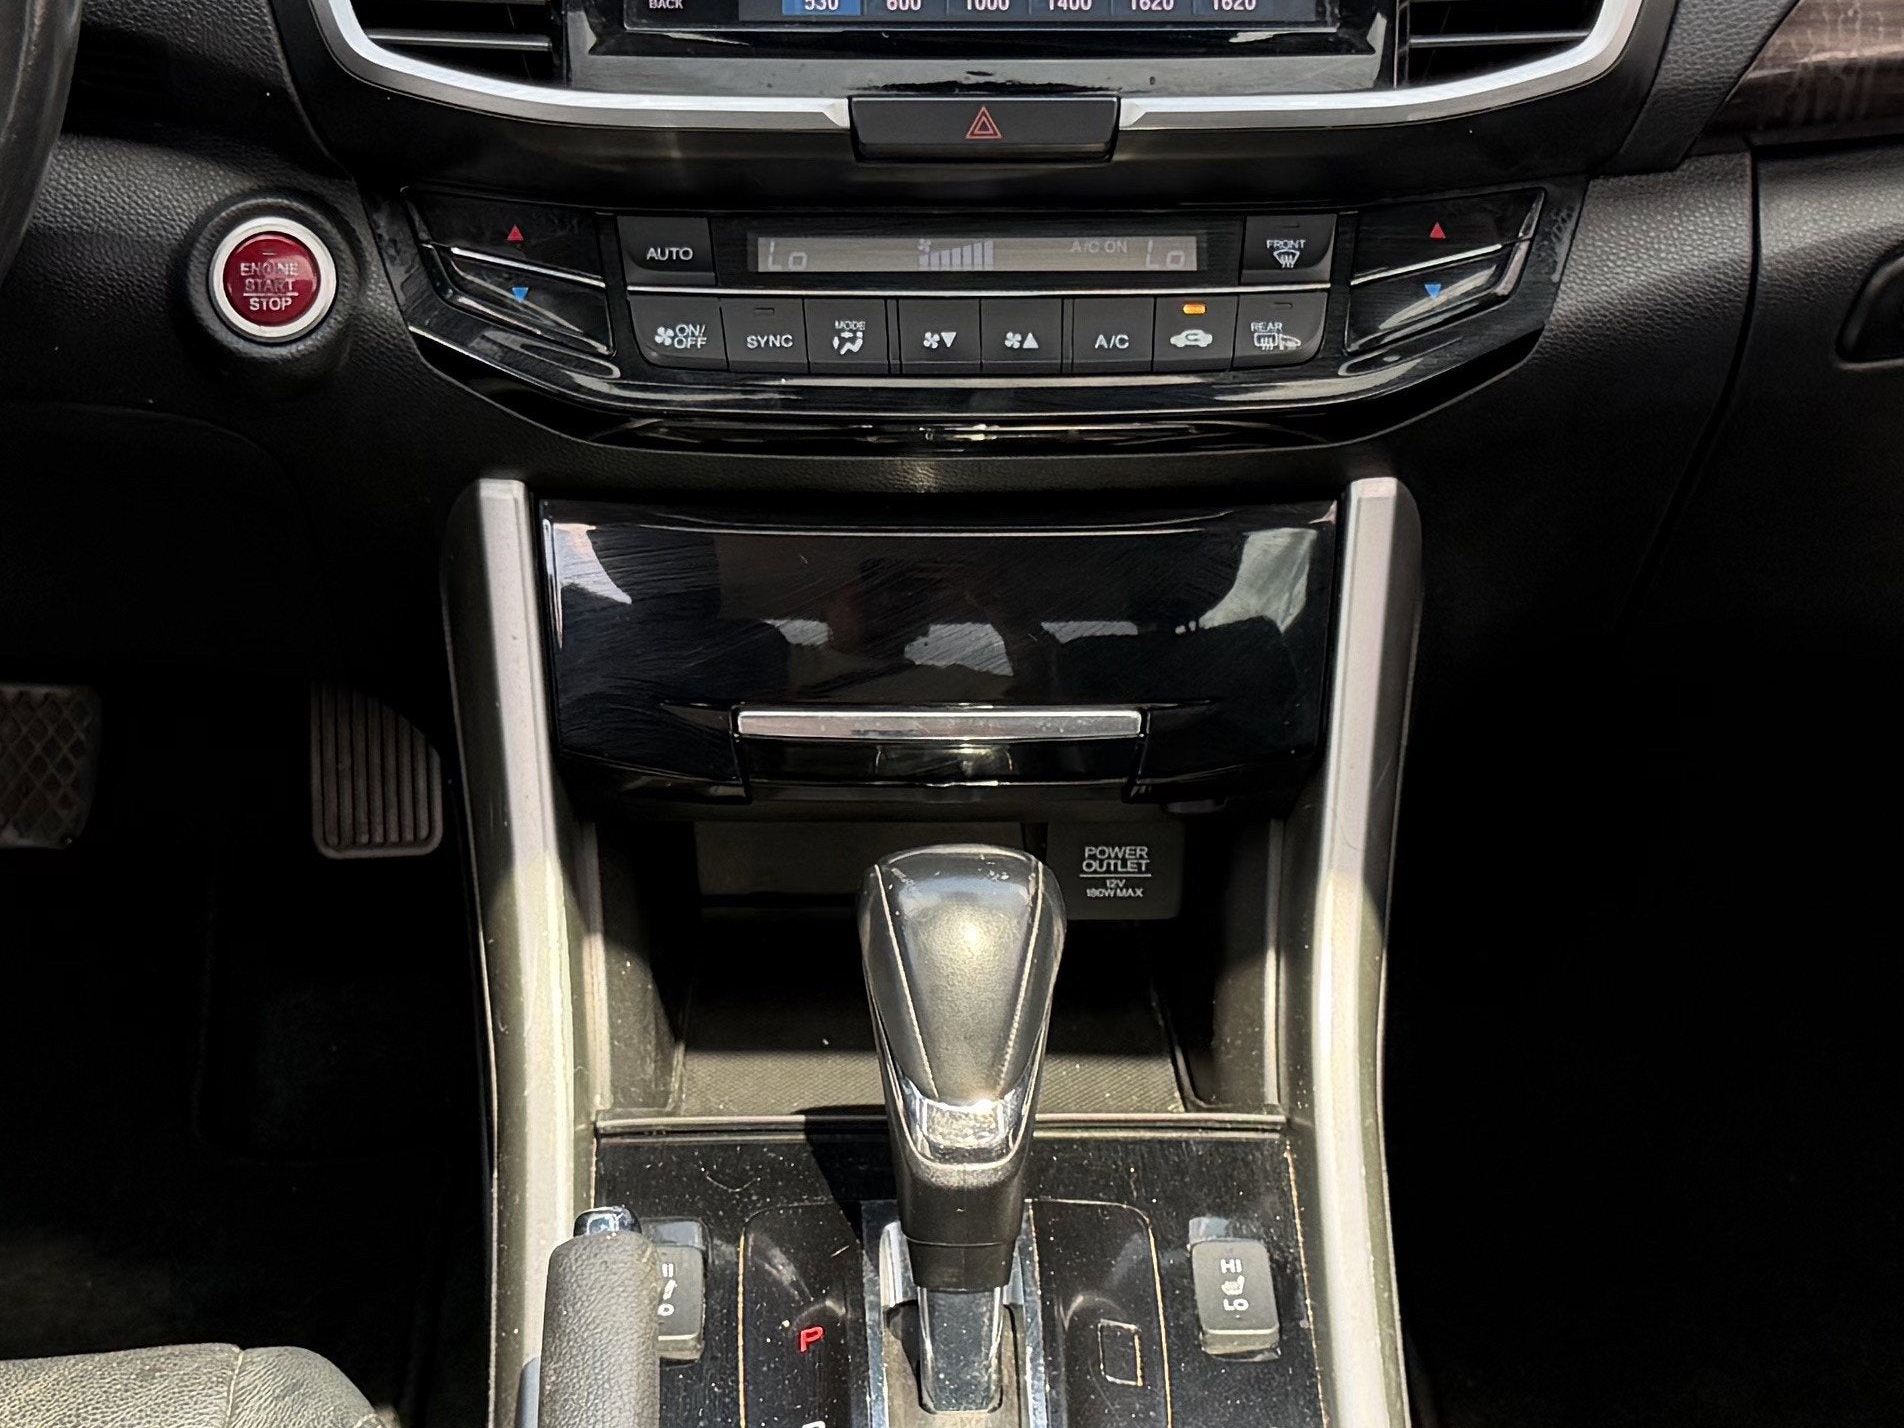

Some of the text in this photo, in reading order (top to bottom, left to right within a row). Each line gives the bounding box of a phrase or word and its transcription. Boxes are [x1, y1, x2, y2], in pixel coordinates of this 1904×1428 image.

[1070, 239, 1128, 254] A/C ON
[1266, 239, 1307, 250] FRONT
[646, 247, 694, 262] AUTO
[240, 262, 299, 277] ENGINE
[245, 277, 295, 292] START
[249, 297, 293, 312] STOP
[675, 324, 706, 337] ON/
[834, 320, 866, 331] MODE
[1250, 322, 1284, 332] REAR
[673, 336, 708, 350] OFF
[746, 335, 794, 349] SYNC
[1094, 334, 1130, 349] A/C
[1084, 846, 1149, 859] POWER
[1082, 859, 1151, 872] OUTLET
[1106, 879, 1127, 888] 12V
[1116, 888, 1144, 898] MAX
[1220, 1258, 1243, 1274] HI
[1222, 1298, 1250, 1311] LO
[799, 1326, 825, 1353] P
